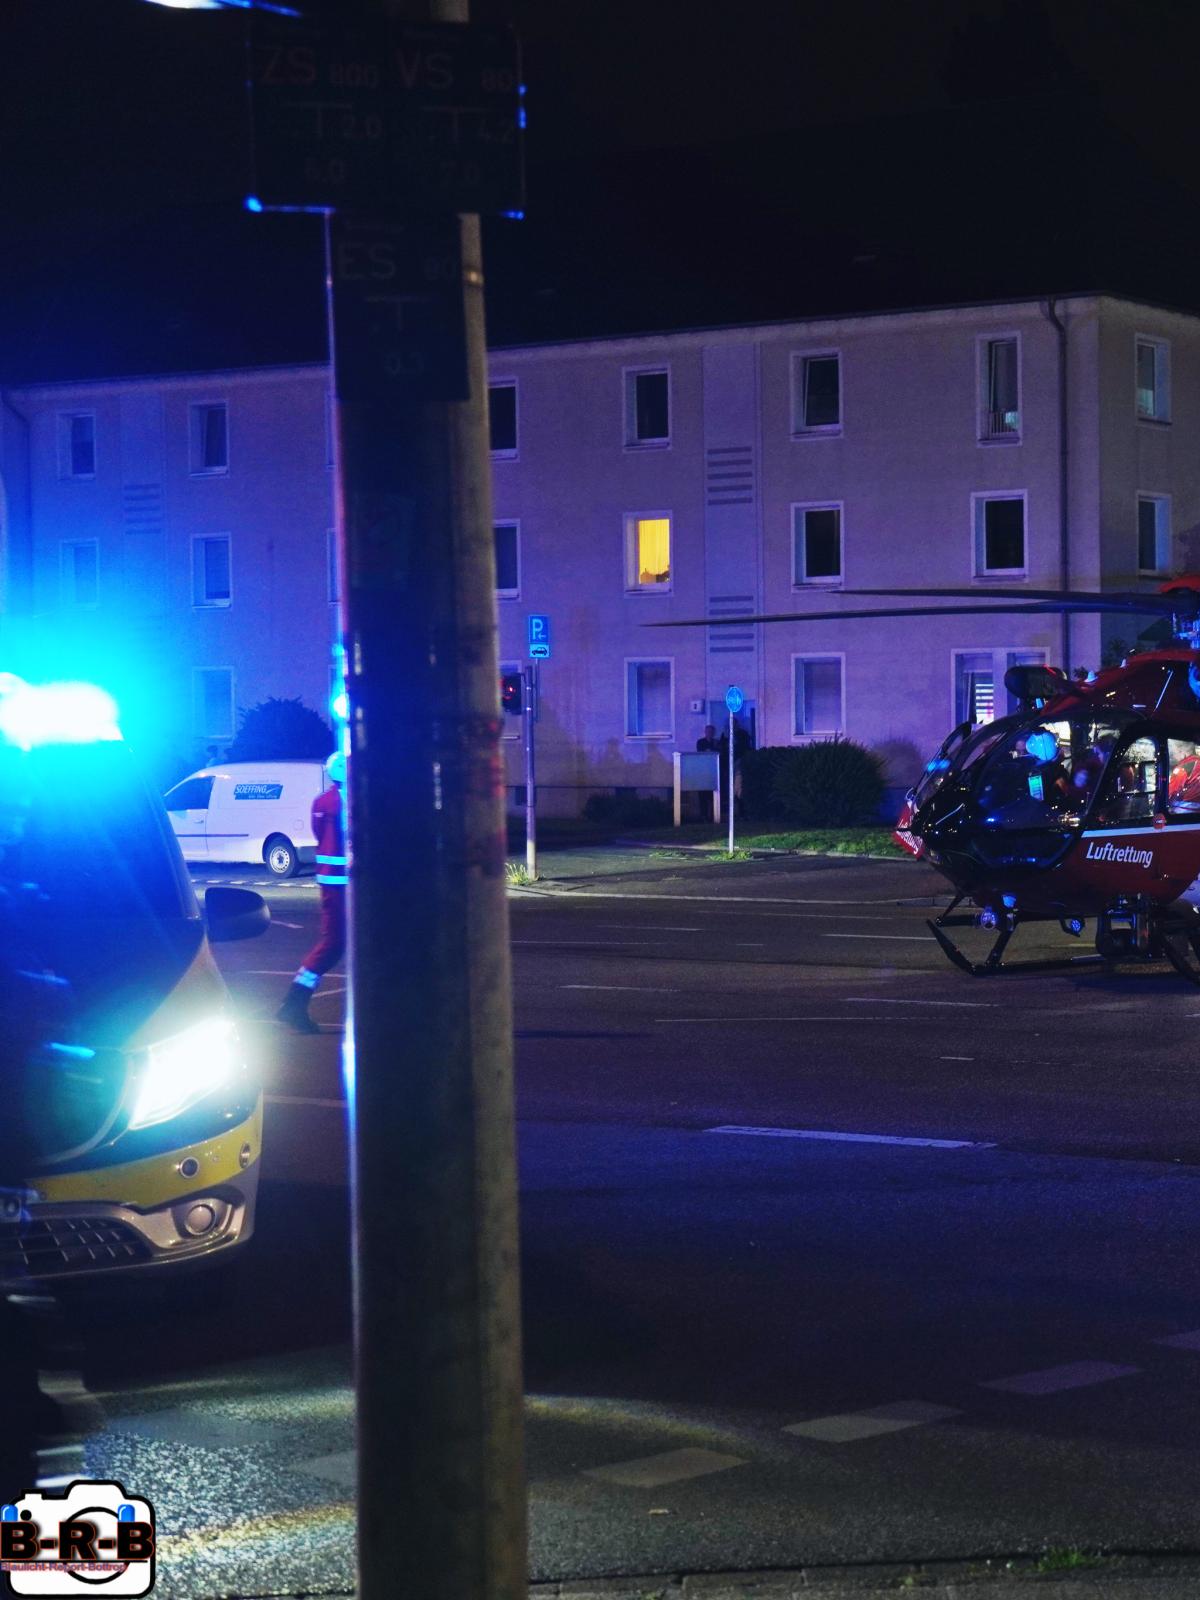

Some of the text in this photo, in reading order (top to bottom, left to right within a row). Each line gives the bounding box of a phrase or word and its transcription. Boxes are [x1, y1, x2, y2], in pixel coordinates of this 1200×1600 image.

[256, 46, 316, 85] ZS
[396, 49, 454, 89] VS
[338, 242, 395, 280] ES
[533, 619, 544, 639] P
[235, 784, 268, 794] SOEFFING
[1086, 842, 1153, 868] Luftrettung
